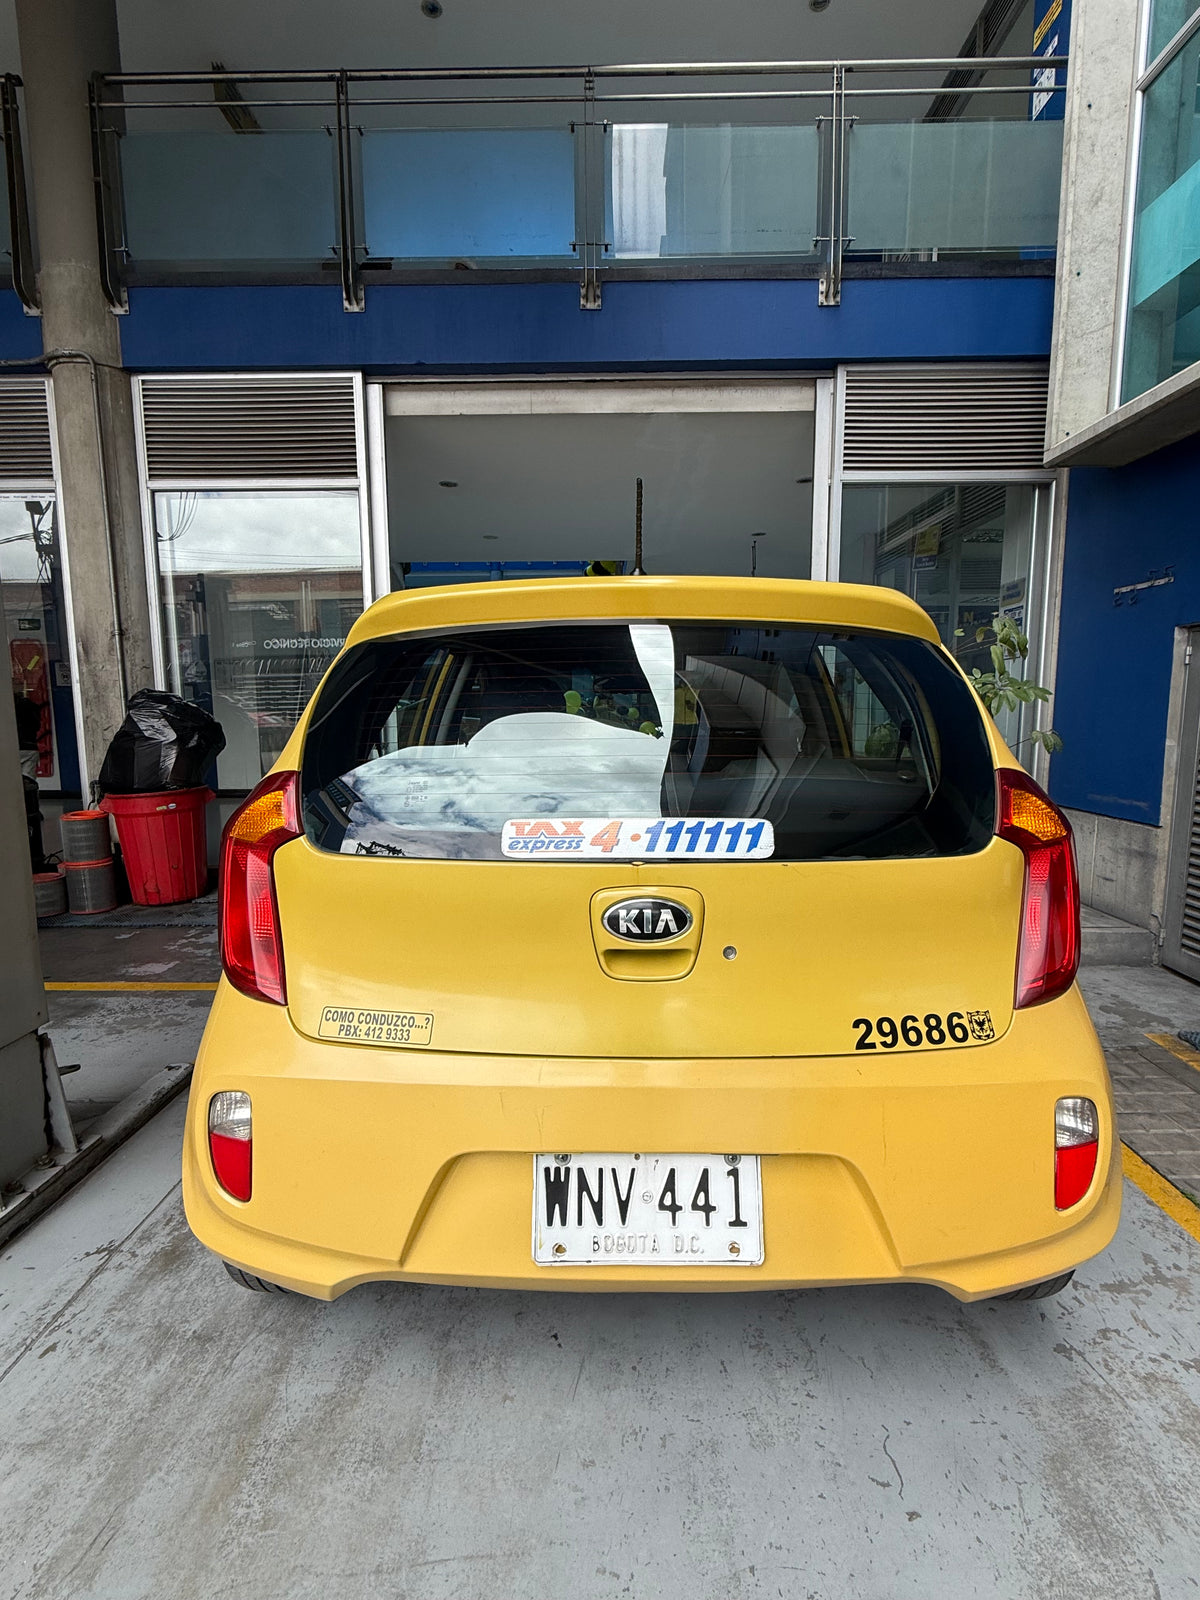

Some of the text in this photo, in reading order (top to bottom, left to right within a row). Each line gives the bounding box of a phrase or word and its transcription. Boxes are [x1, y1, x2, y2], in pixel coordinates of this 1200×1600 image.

[510, 821, 585, 836] TAX
[508, 838, 583, 853] express
[618, 909, 679, 934] KIA
[324, 1009, 355, 1024] COMO
[338, 1024, 411, 1042] PBX: 412 9333
[852, 1011, 970, 1051] 29686
[543, 1166, 748, 1228] WNV 441
[592, 1234, 705, 1254] BOGOTA D.C.
